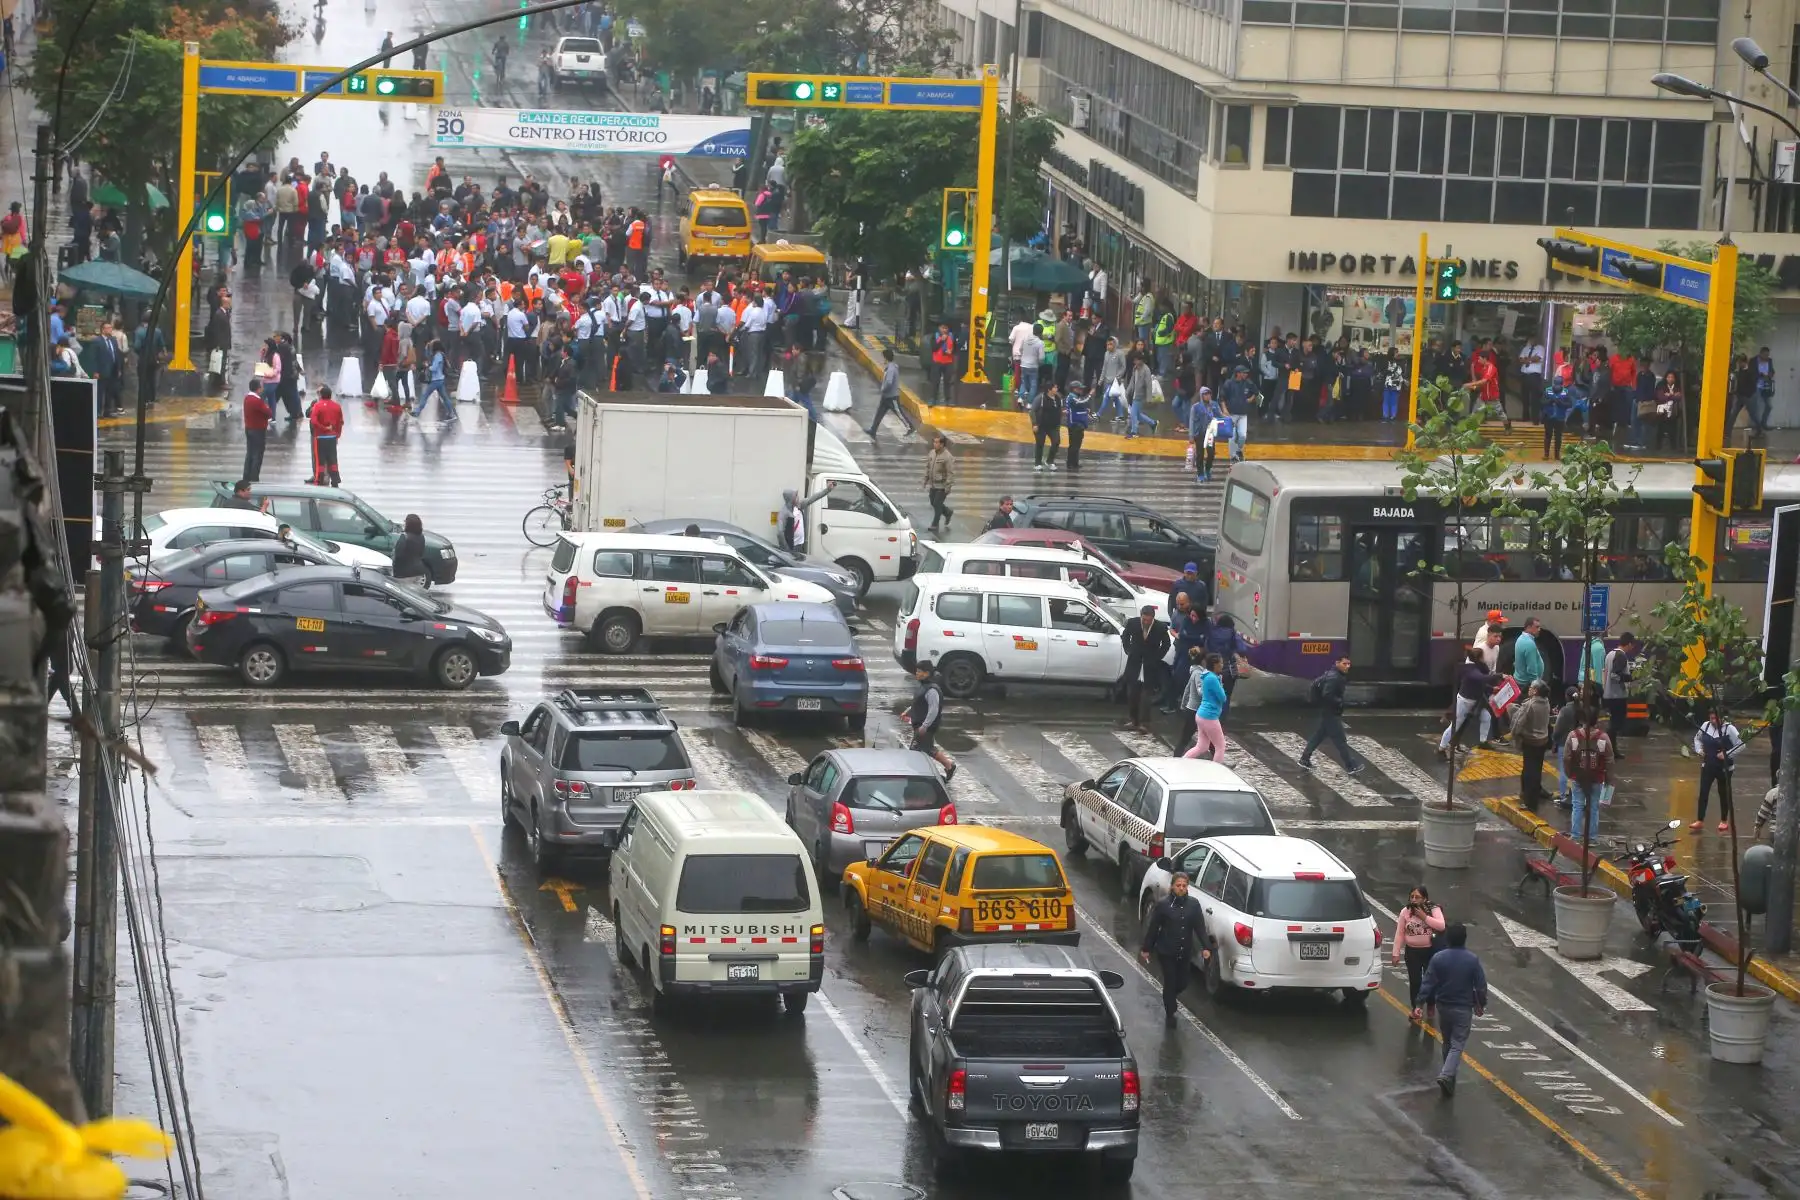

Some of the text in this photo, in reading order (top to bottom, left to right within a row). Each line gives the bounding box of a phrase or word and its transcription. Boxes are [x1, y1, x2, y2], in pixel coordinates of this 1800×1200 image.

[351, 78, 365, 90] 31
[824, 86, 838, 97] 32
[926, 92, 955, 100] ABANCAY
[438, 110, 463, 118] ZONA
[520, 113, 551, 123] PLAN
[552, 114, 567, 124] DE
[437, 118, 465, 136] 30
[509, 126, 668, 144] CENTRO HISTÓRICO
[720, 147, 747, 156] LIMA
[1373, 507, 1415, 518] BAJADA
[1477, 601, 1584, 613] Municipalidad De Li
[684, 925, 804, 935] MITSUBISHI
[993, 1094, 1094, 1111] TOYOTA
